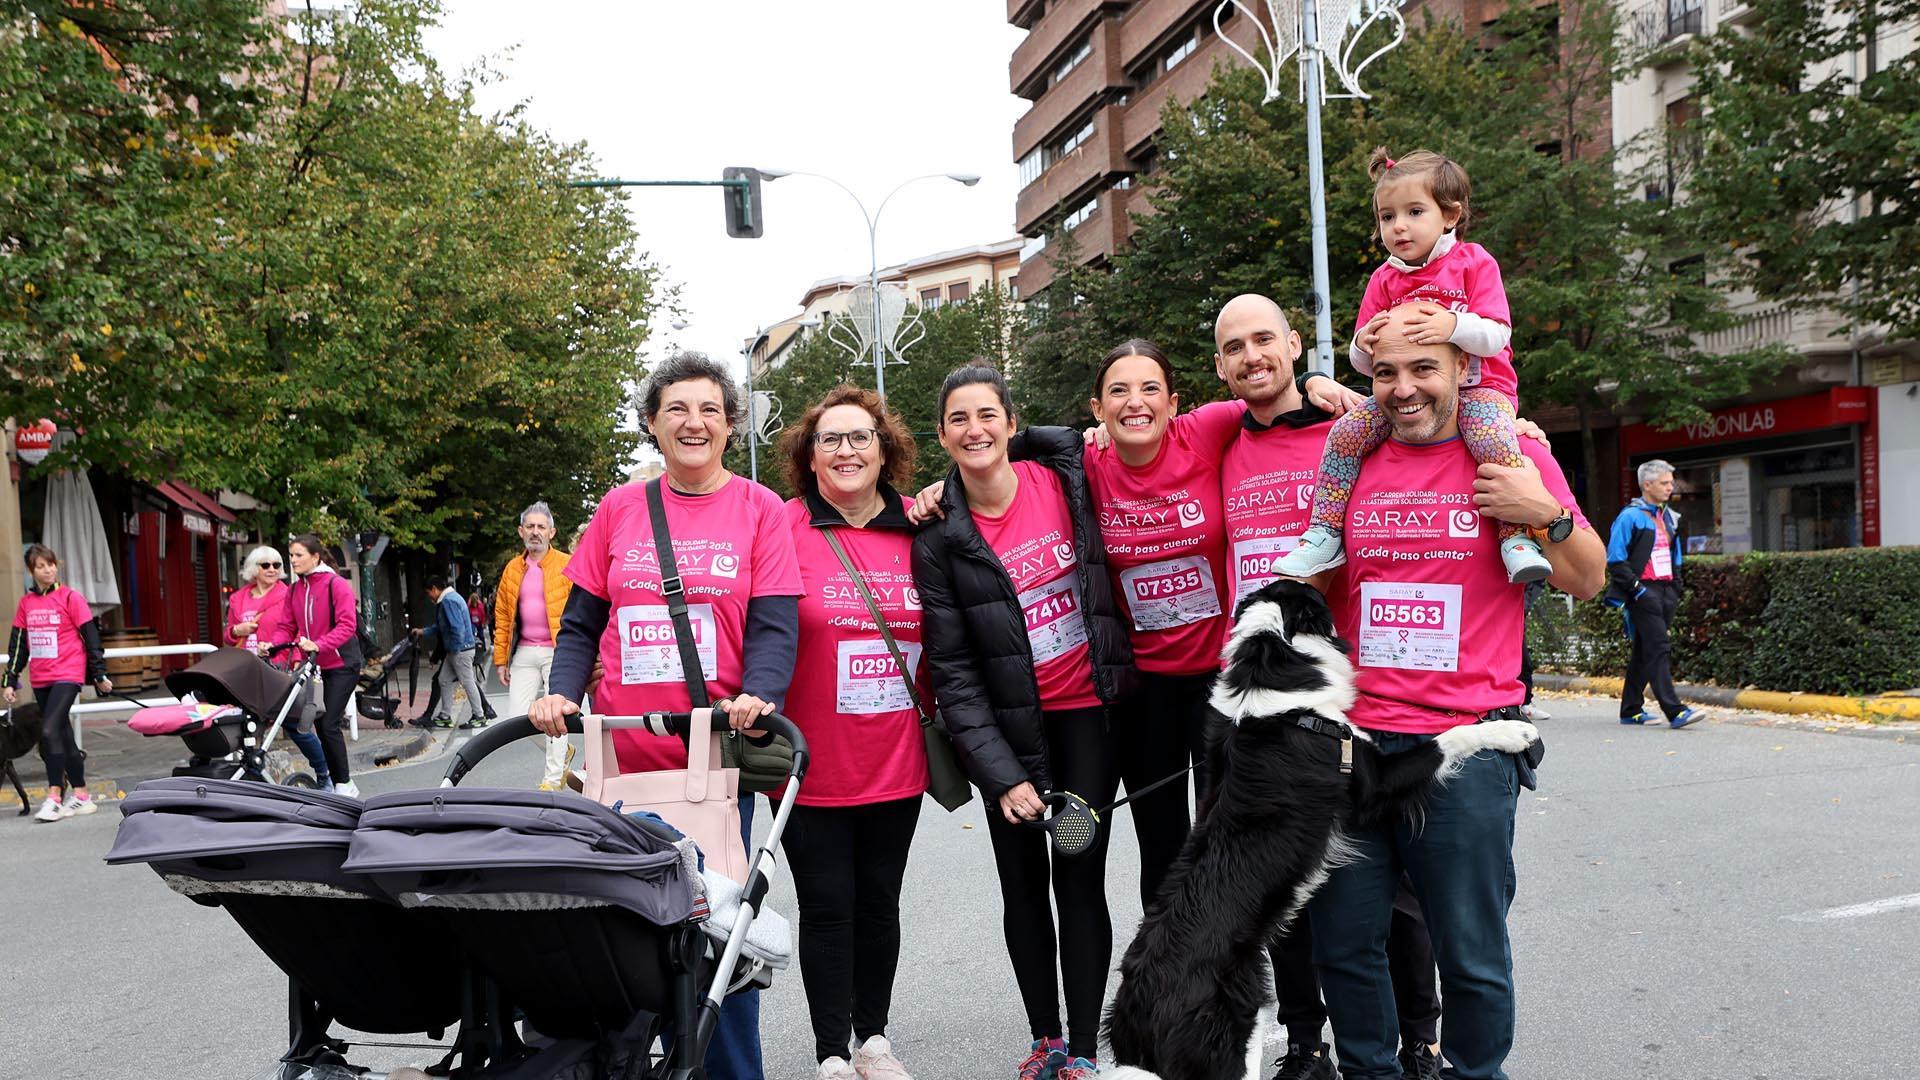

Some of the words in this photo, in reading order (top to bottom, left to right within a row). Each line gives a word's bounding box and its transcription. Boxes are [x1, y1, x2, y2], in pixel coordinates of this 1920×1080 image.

[1686, 408, 1776, 440] VISIONLAB
[1290, 470, 1314, 480] 2023
[1166, 490, 1189, 504] 2023
[1227, 487, 1289, 512] SARAY
[1440, 494, 1469, 505] 2023
[1101, 510, 1169, 527] SARAY
[1352, 511, 1438, 526] SARAY
[1040, 530, 1061, 546] 2023
[1255, 527, 1276, 538] paso
[709, 542, 732, 551] 2023
[1135, 546, 1159, 556] paso
[624, 549, 705, 567] SAAY
[1392, 550, 1420, 561] paso
[1424, 550, 1473, 560] cuenta”
[1007, 552, 1044, 579] RAY
[1241, 557, 1270, 576] 009
[1136, 571, 1199, 596] 07335
[688, 586, 730, 597] cuenta”
[1372, 604, 1441, 624] 05563
[861, 621, 880, 630] pas
